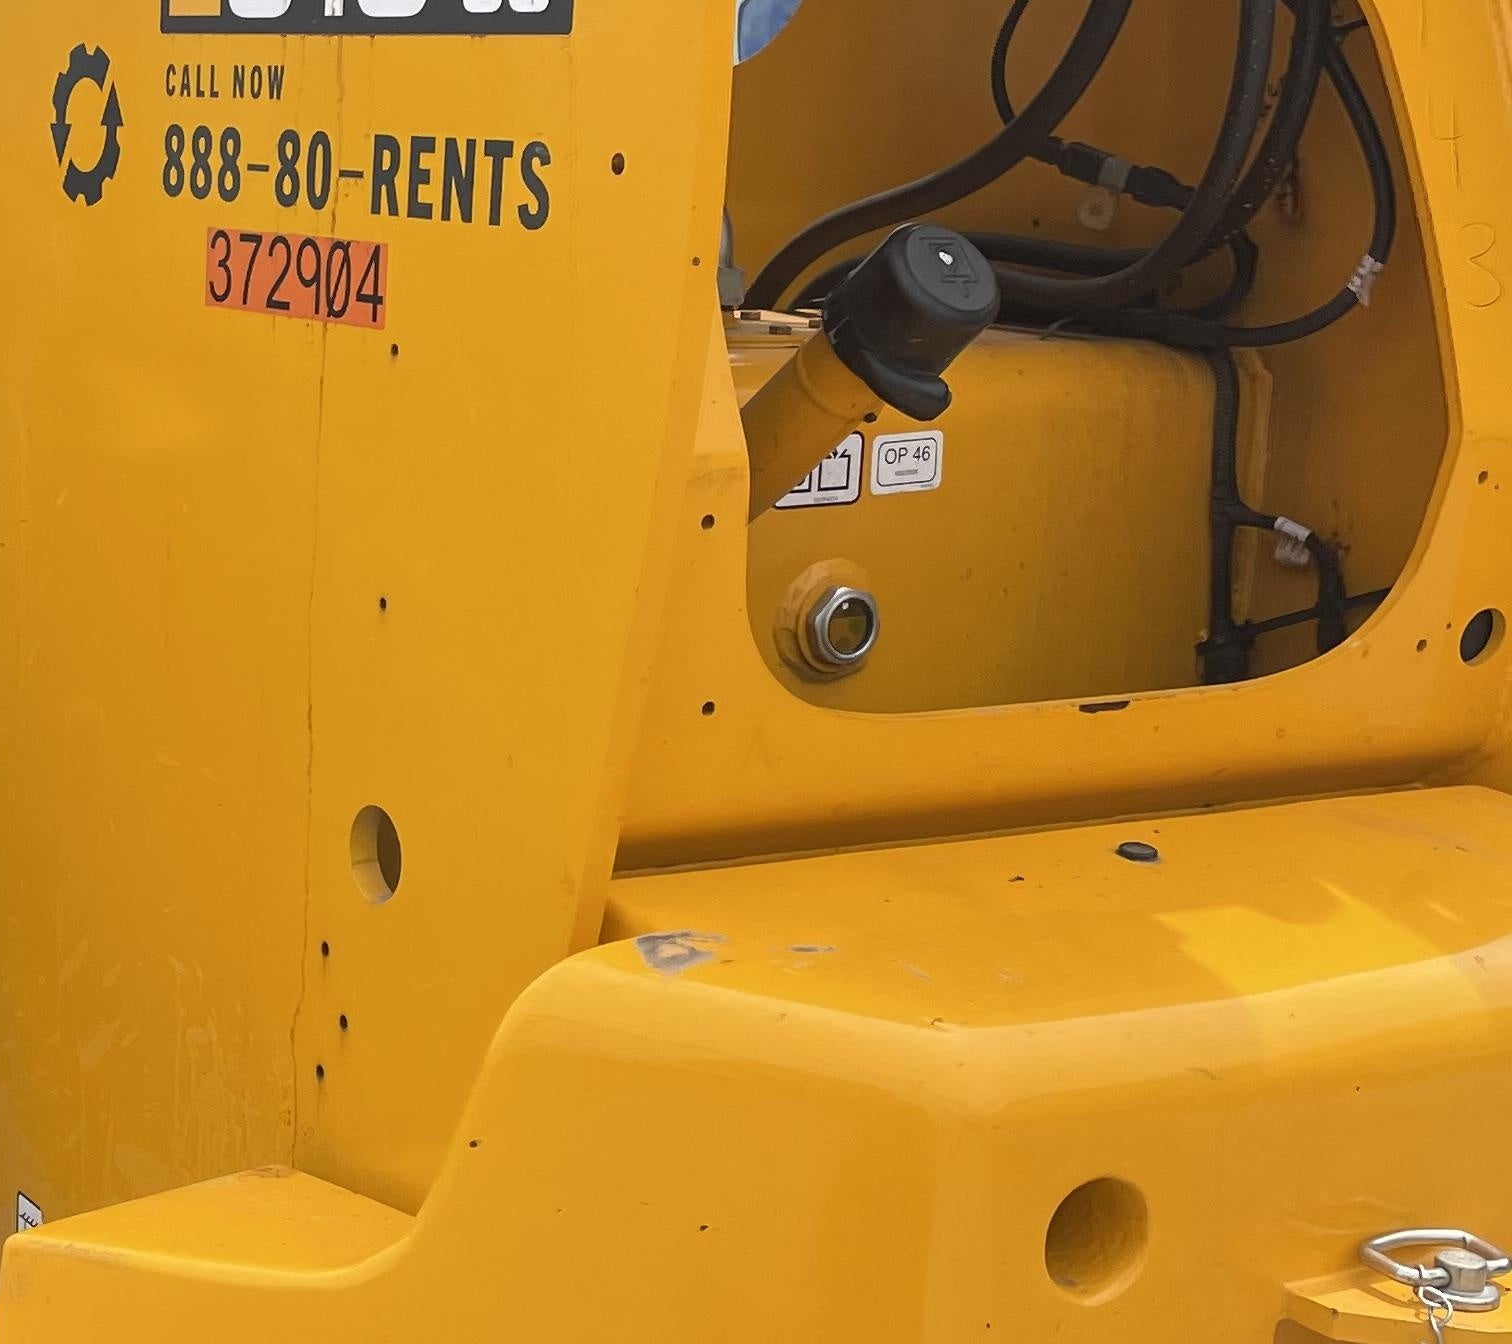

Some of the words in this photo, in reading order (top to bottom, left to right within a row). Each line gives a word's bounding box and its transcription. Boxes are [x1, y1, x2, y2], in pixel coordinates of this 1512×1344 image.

[165, 63, 219, 98] CALL
[232, 64, 285, 100] NOW
[162, 123, 552, 230] 888-80-RENTS
[209, 229, 384, 323] 372904
[884, 447, 908, 464] OP
[912, 445, 931, 462] 46
